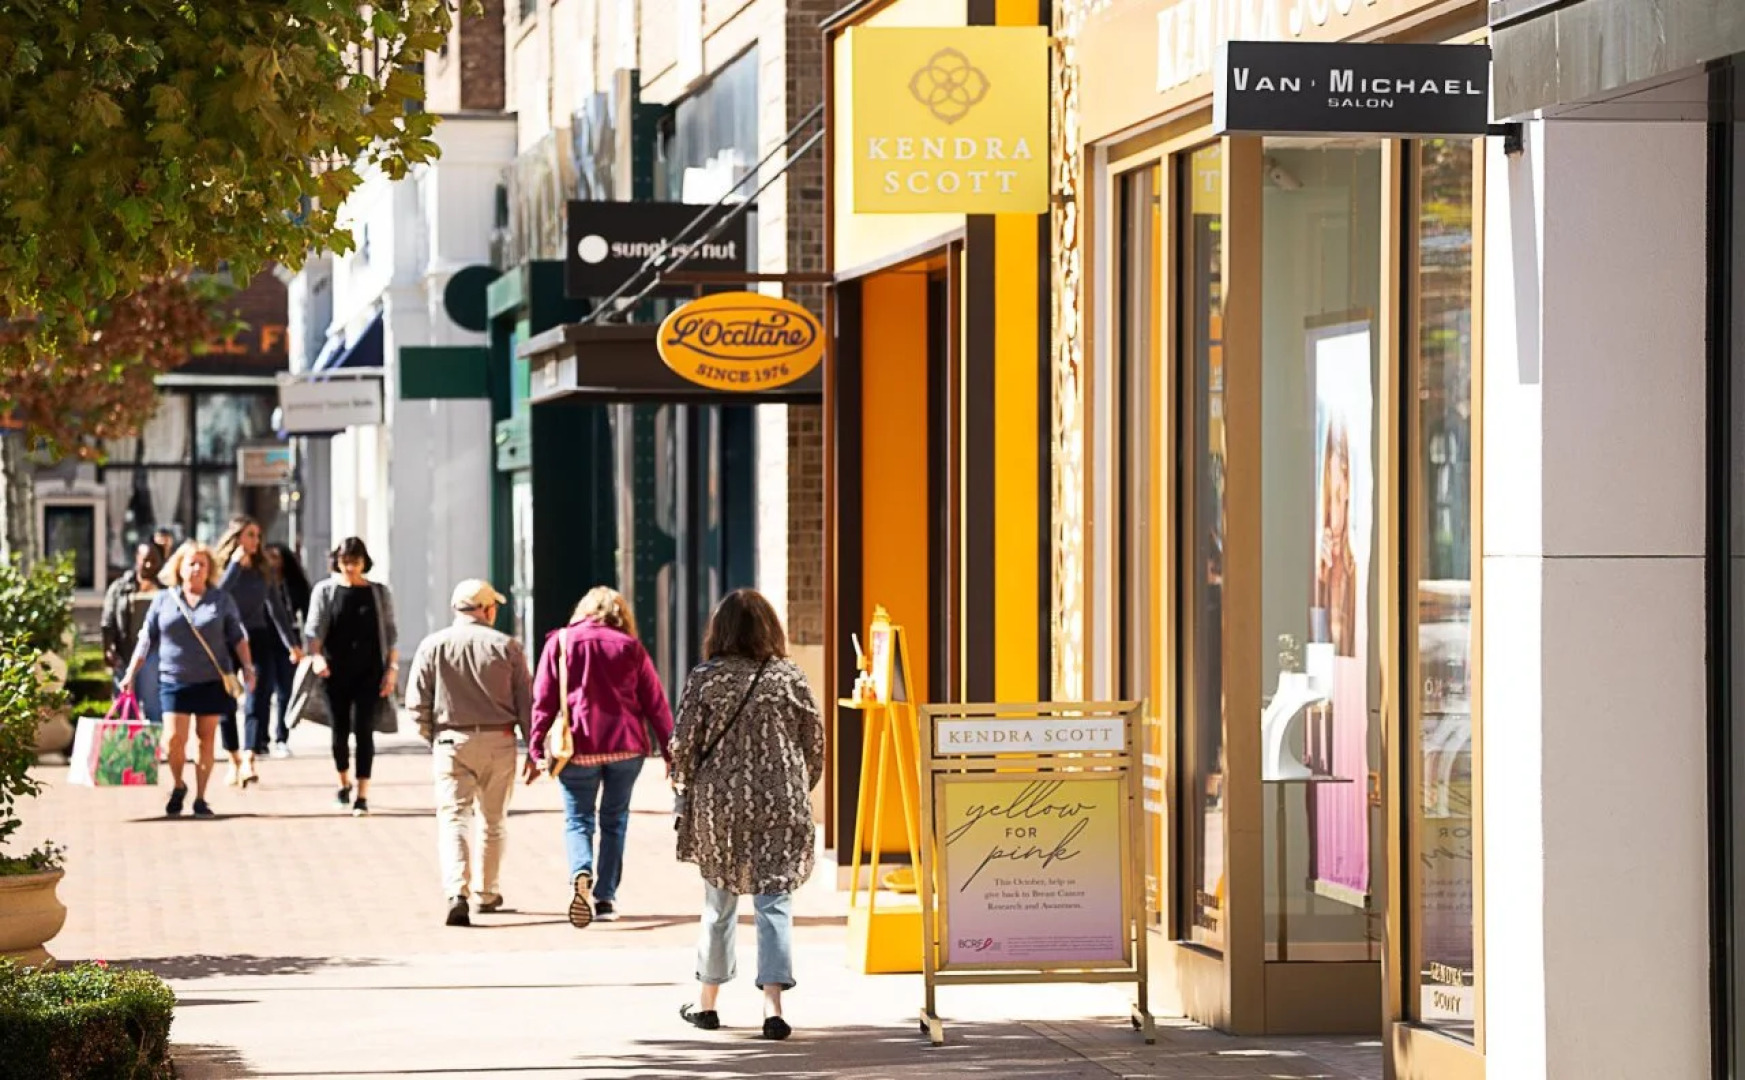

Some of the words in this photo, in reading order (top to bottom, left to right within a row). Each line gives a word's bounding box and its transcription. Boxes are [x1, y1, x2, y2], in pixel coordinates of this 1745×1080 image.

[1329, 69, 1484, 95] MICHAEL
[1327, 97, 1395, 109] SALON
[868, 136, 1032, 161] KENDRA
[883, 170, 1018, 194] SCOTT
[695, 363, 750, 383] SINCE
[755, 363, 790, 382] 1976
[949, 730, 1034, 744] KENDRA
[1043, 728, 1113, 742] SCOTT
[945, 780, 1096, 847] yellow
[1005, 827, 1037, 838] FOR
[960, 817, 1089, 892] pink
